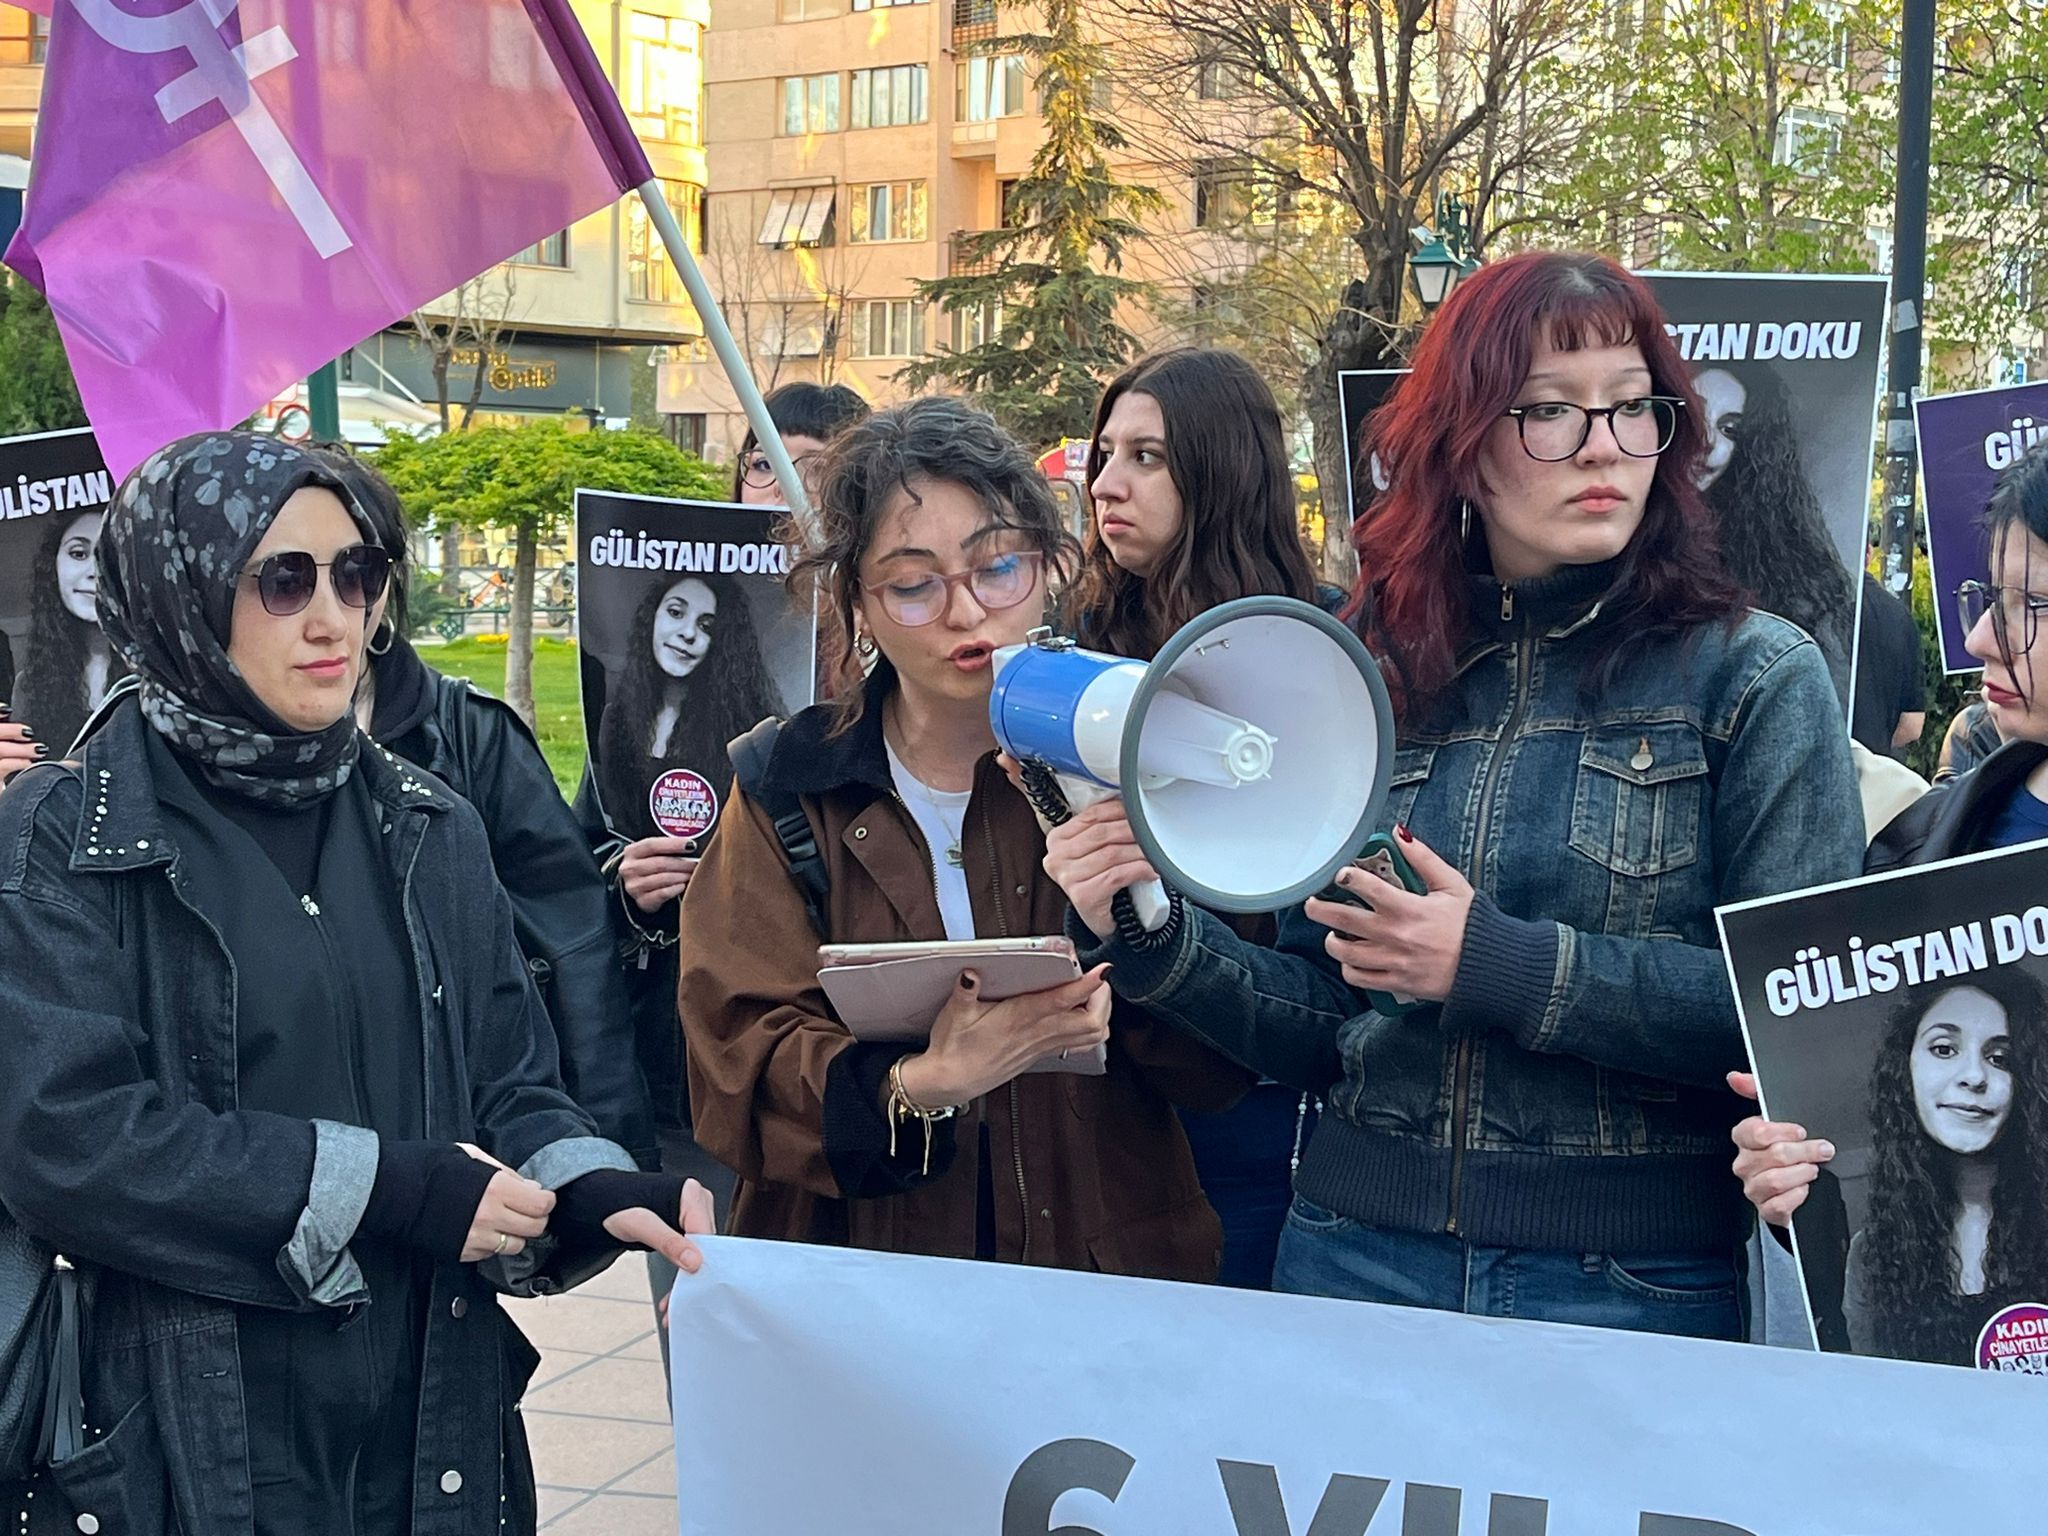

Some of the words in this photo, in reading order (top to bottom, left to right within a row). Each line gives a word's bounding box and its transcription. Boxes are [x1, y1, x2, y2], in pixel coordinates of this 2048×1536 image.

[1753, 321, 1862, 360] DOKU
[590, 529, 716, 573] GÜLİSTAN
[664, 777, 701, 790] KADIN
[1764, 920, 1989, 1017] GÜLİSTAN
